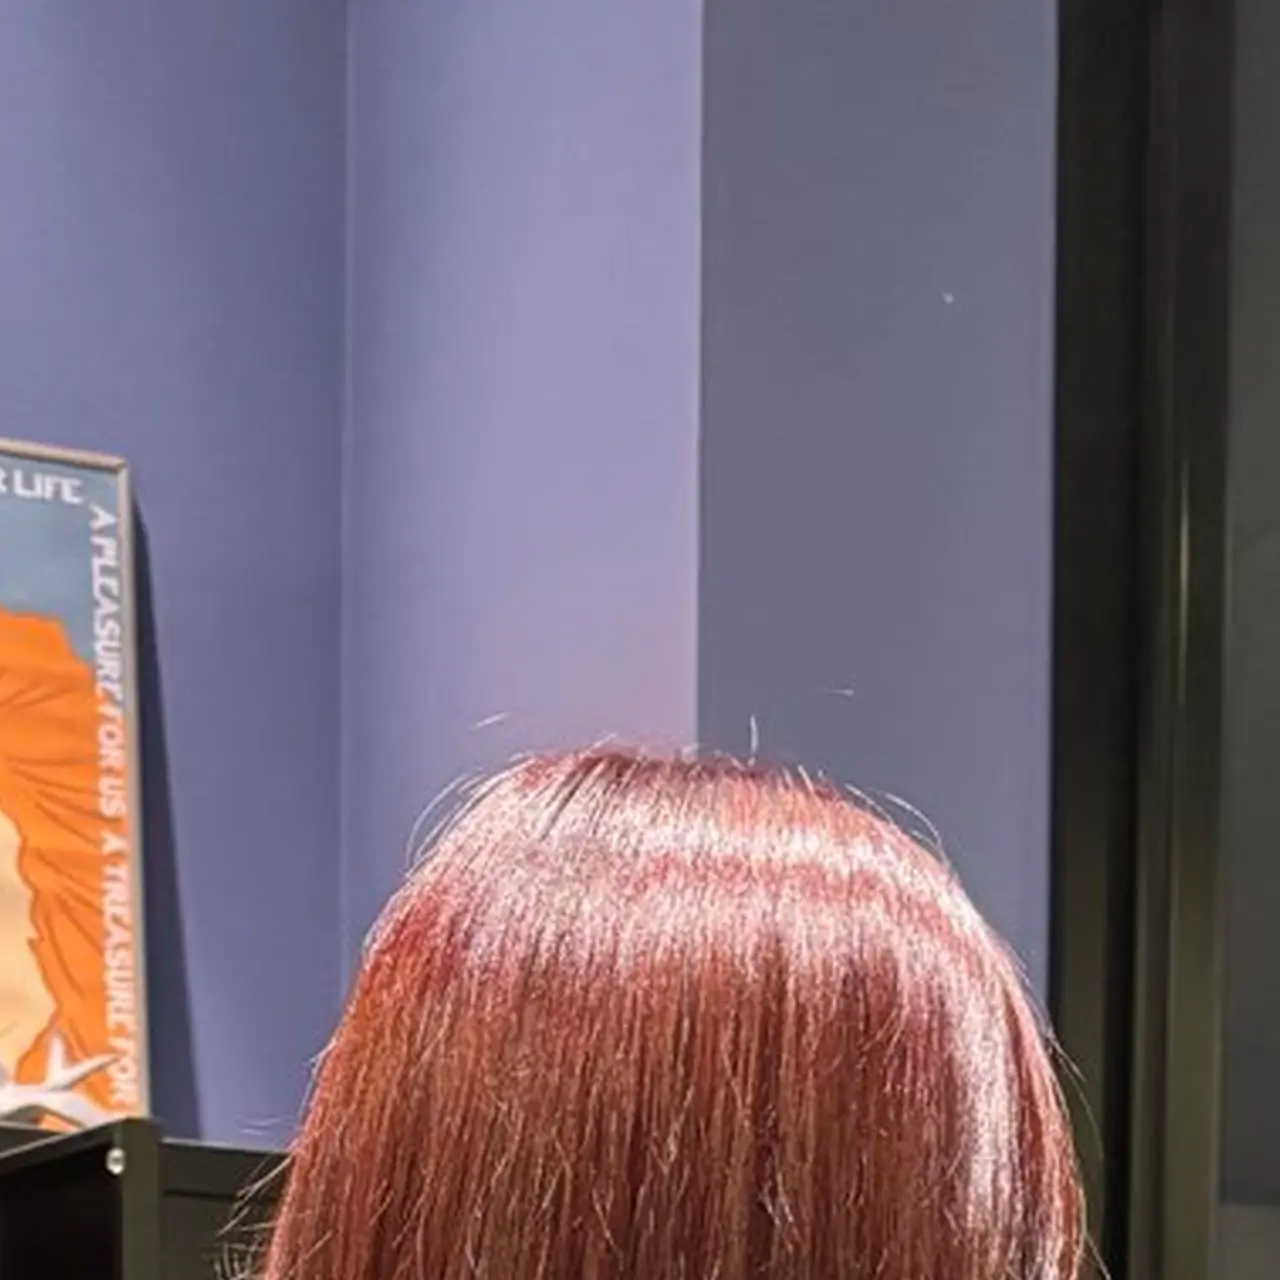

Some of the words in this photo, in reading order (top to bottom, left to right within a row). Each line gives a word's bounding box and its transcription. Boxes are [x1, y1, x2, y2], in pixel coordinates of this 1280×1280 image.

[12, 470, 84, 504] LIFE
[89, 503, 116, 532] A
[91, 535, 122, 701] PLEASURE
[98, 776, 127, 817] US
